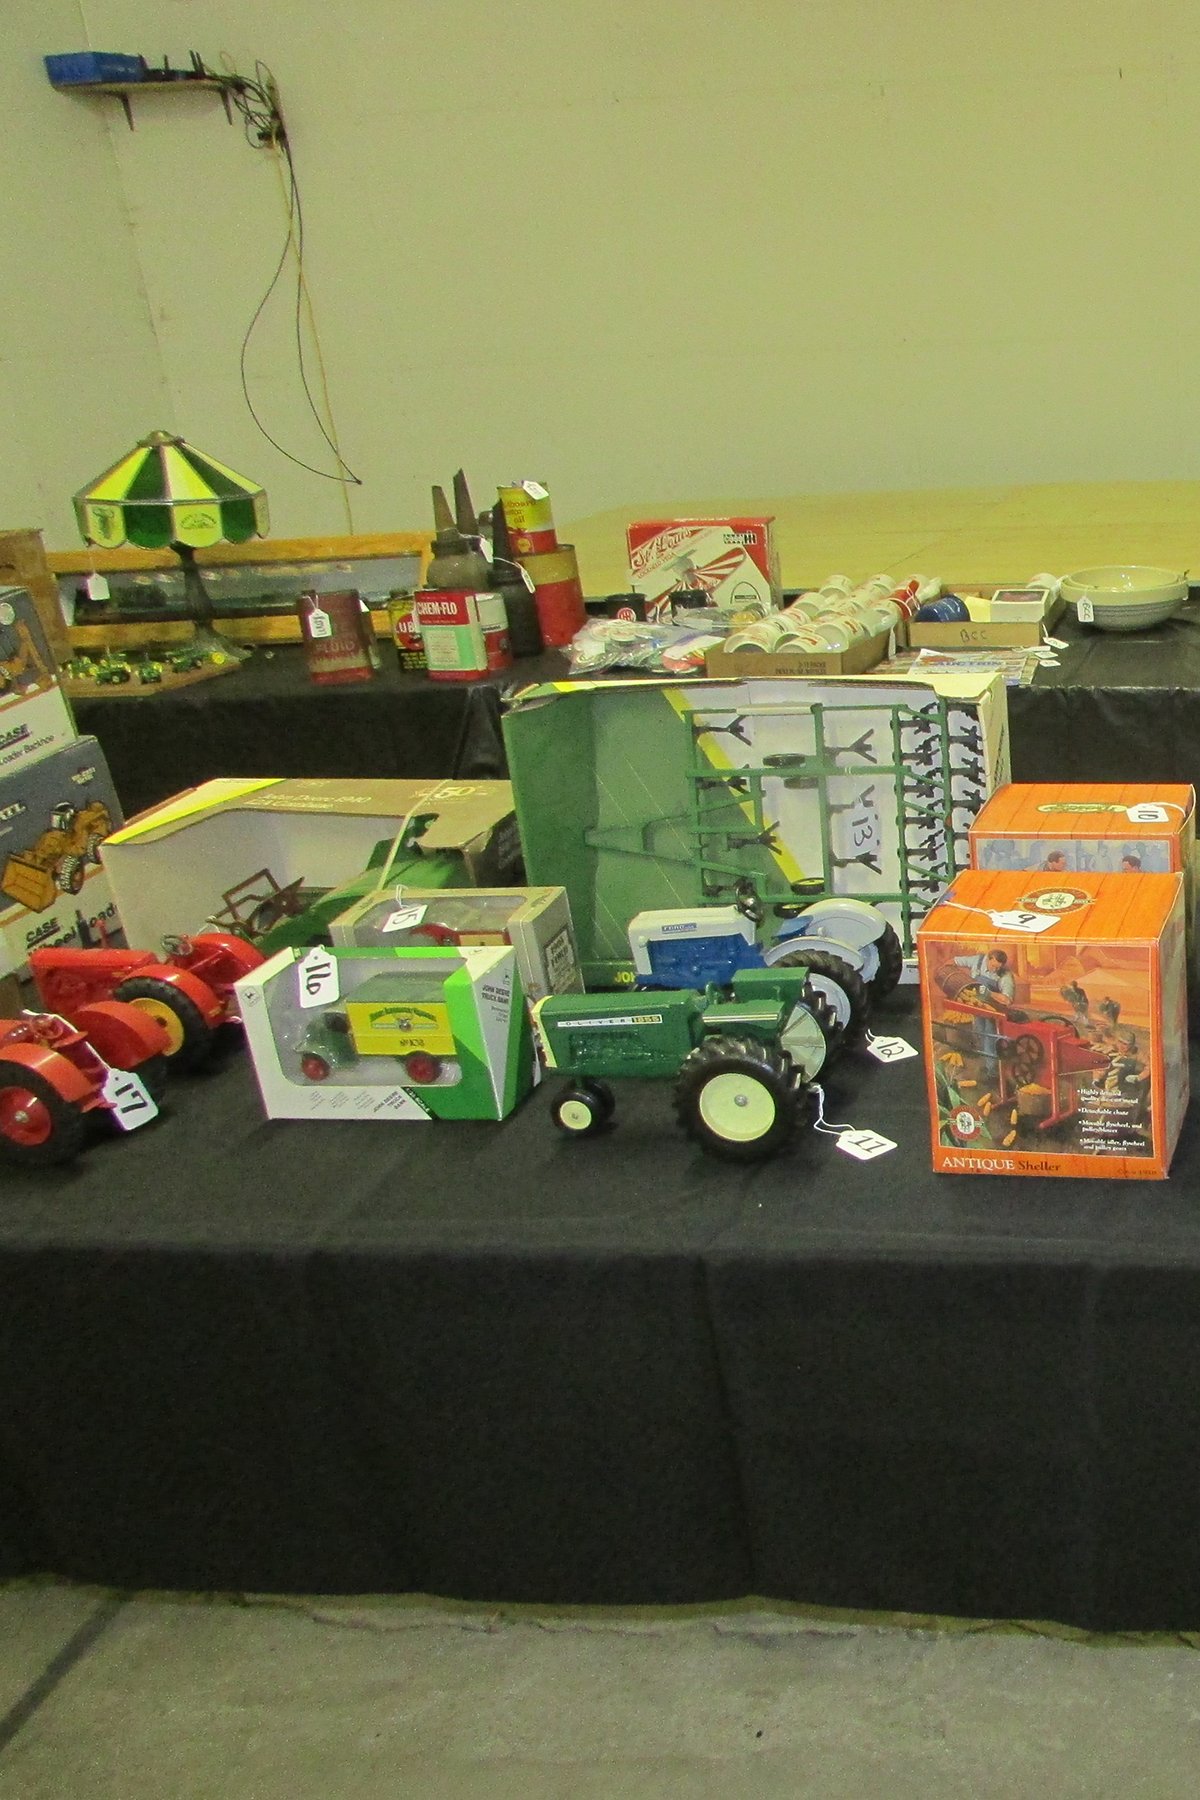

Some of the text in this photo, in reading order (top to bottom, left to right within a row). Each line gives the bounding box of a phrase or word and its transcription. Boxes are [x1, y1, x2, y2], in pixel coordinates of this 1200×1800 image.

[655, 529, 693, 556] Louis
[417, 601, 457, 615] CHEM-FLO
[1137, 809, 1160, 821] 10
[851, 816, 873, 847] 13
[393, 906, 420, 927] 15
[1018, 912, 1037, 925] 9
[26, 917, 58, 943] CASE
[305, 962, 332, 996] 16
[564, 1018, 626, 1027] OLIVER
[876, 1041, 905, 1059] 12
[114, 1082, 148, 1114] 17
[847, 1136, 888, 1154] 11
[941, 1156, 1062, 1172] ANTIQUE Sheller
